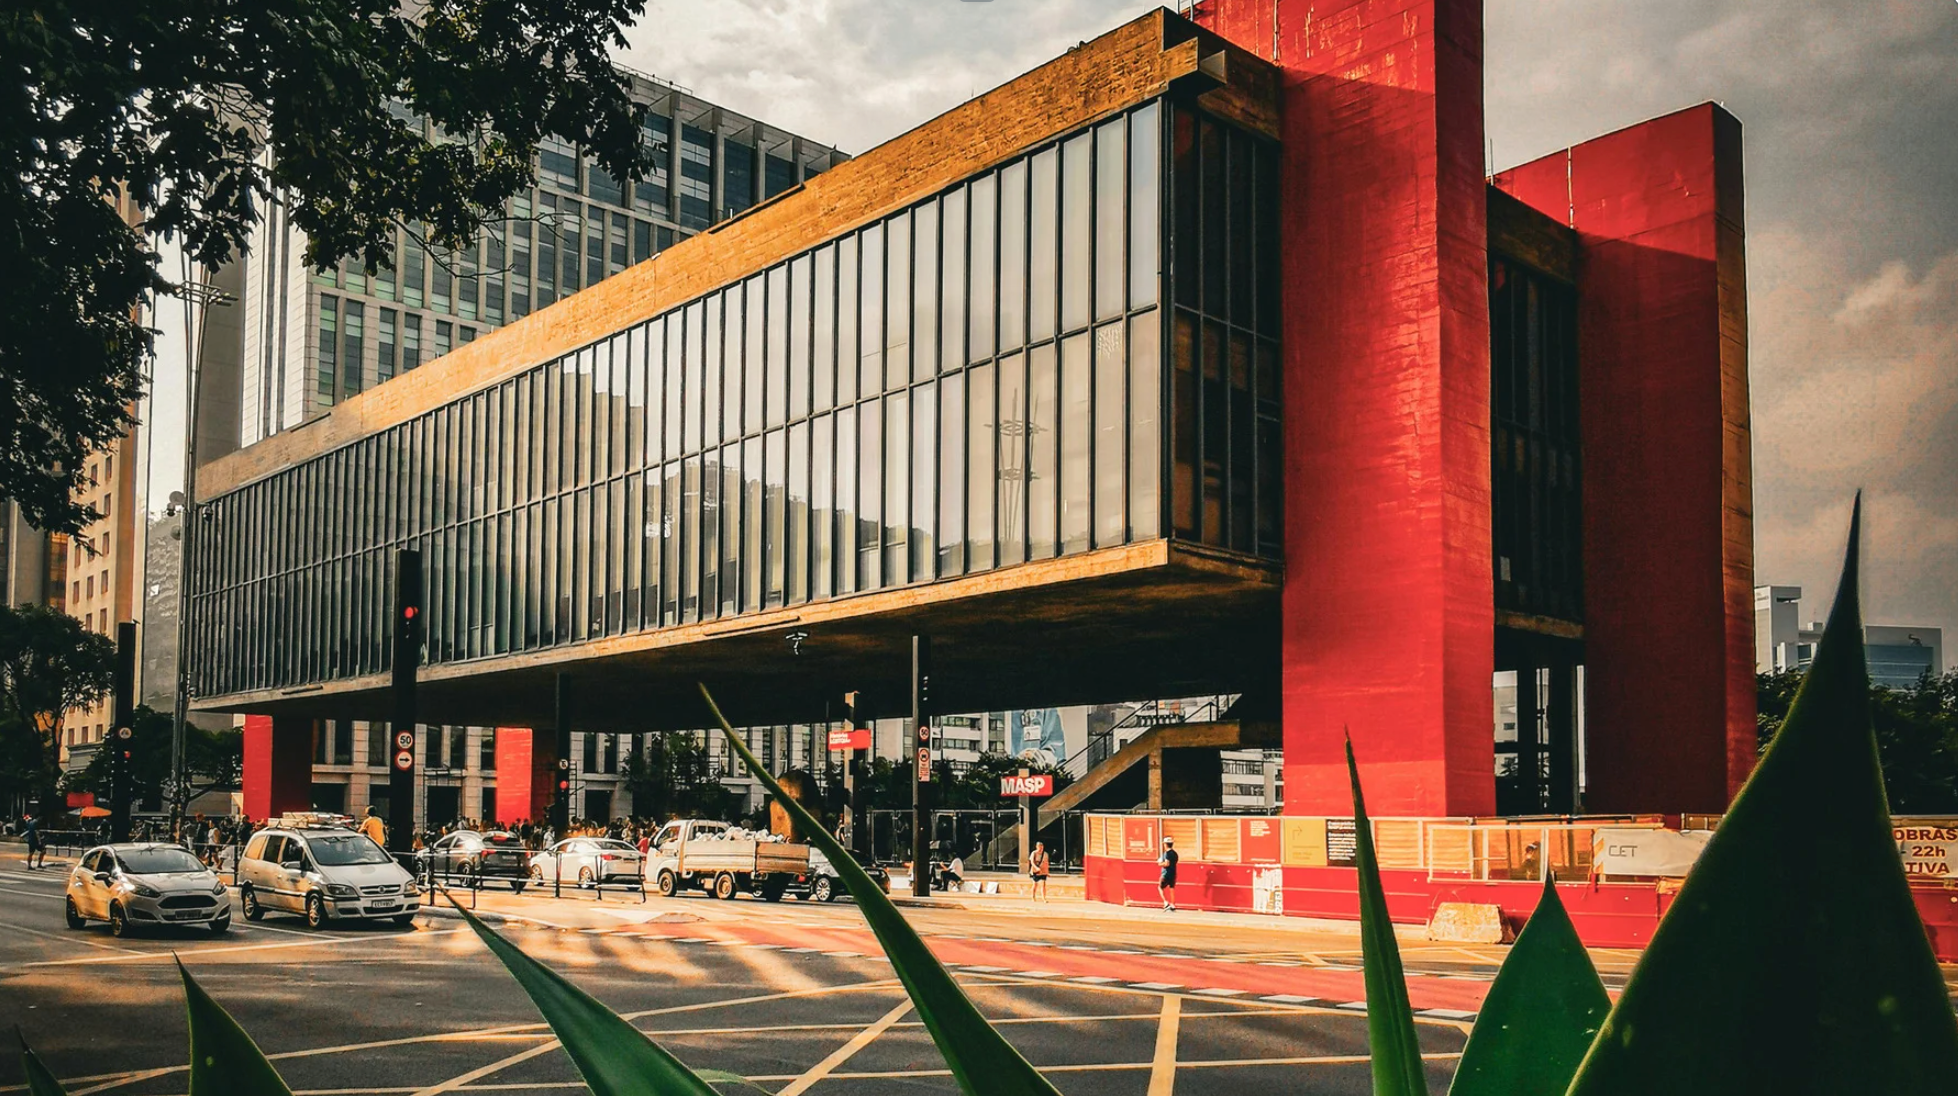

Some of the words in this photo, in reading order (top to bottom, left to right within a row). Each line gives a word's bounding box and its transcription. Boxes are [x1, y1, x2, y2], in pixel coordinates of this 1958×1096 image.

[400, 735, 411, 745] 50
[1001, 777, 1045, 794] MASP
[1893, 828, 1957, 840] OBRAS
[1609, 845, 1637, 857] CET
[1912, 845, 1946, 857] 22h
